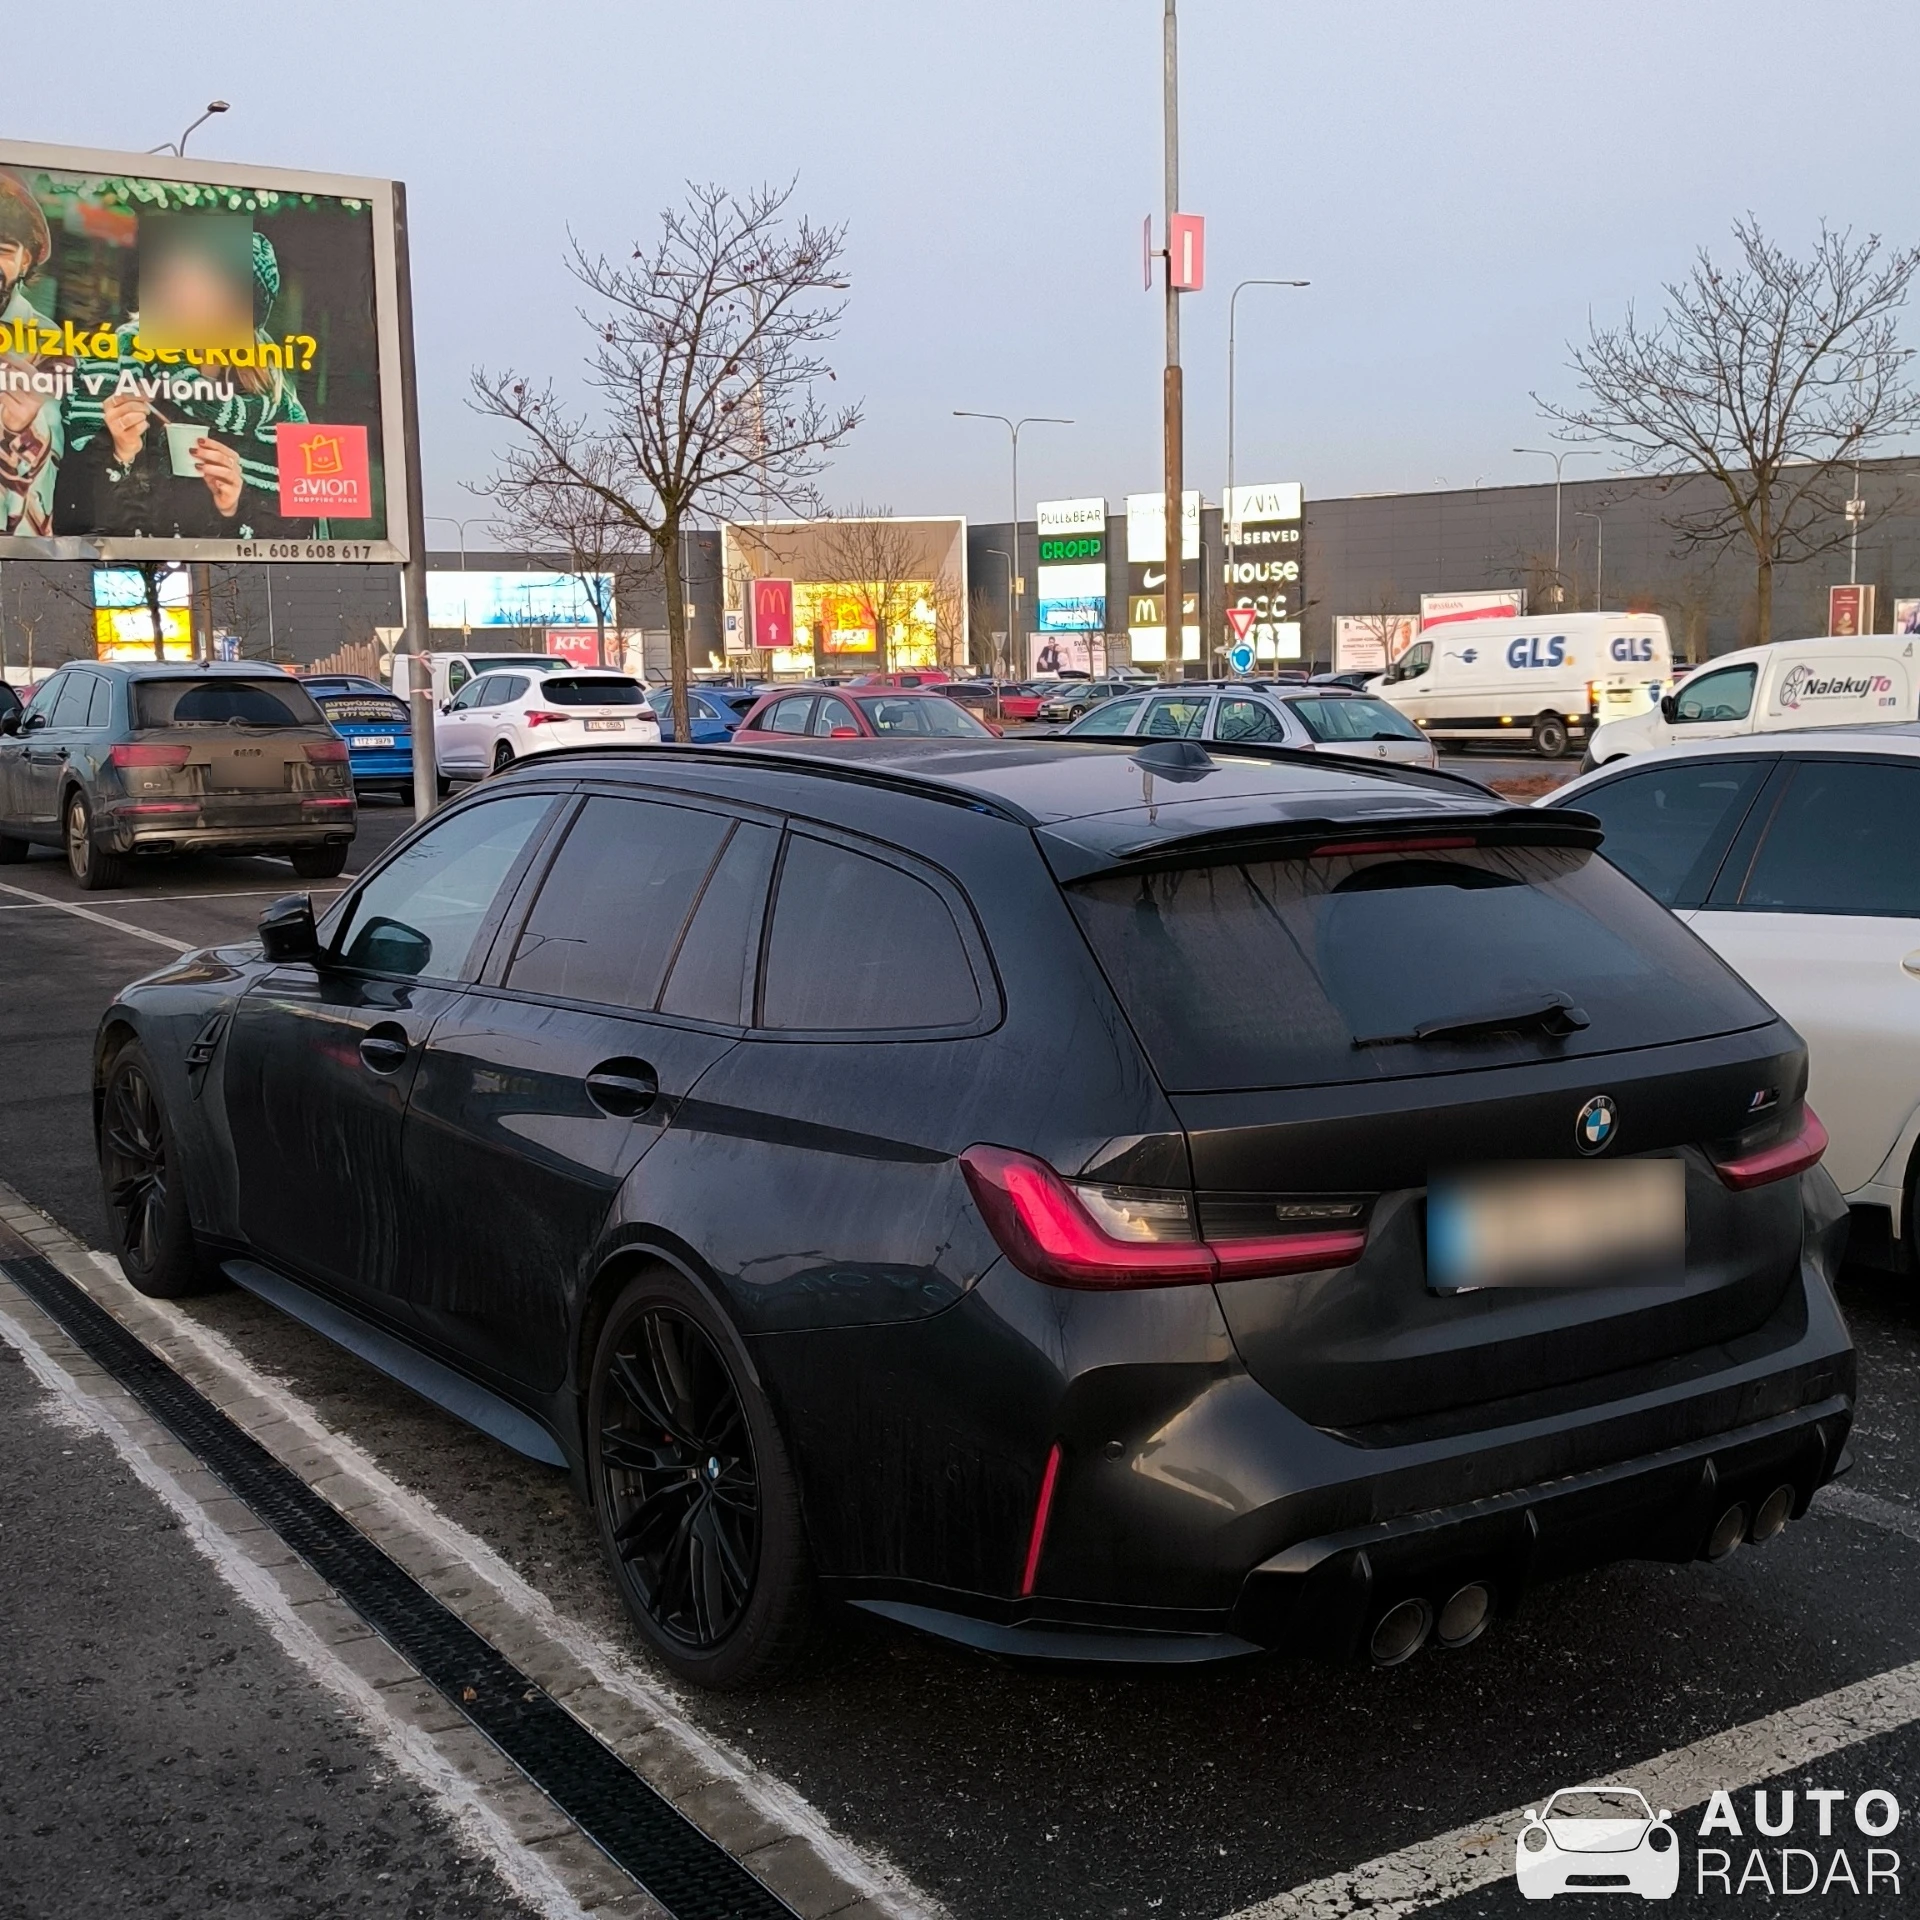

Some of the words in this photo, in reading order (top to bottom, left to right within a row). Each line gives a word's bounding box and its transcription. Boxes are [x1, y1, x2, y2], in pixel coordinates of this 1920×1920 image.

[84, 374, 104, 396] v
[114, 369, 235, 401] Avionu
[293, 478, 358, 495] avion
[1041, 509, 1101, 525] PULL&BEAR
[236, 543, 263, 558] tel.
[269, 544, 300, 558] 608
[306, 545, 336, 559] 608
[342, 545, 372, 560] 617
[1042, 539, 1101, 560] CROPP
[553, 635, 593, 650] KFC
[1803, 675, 1893, 699] NalakujTo
